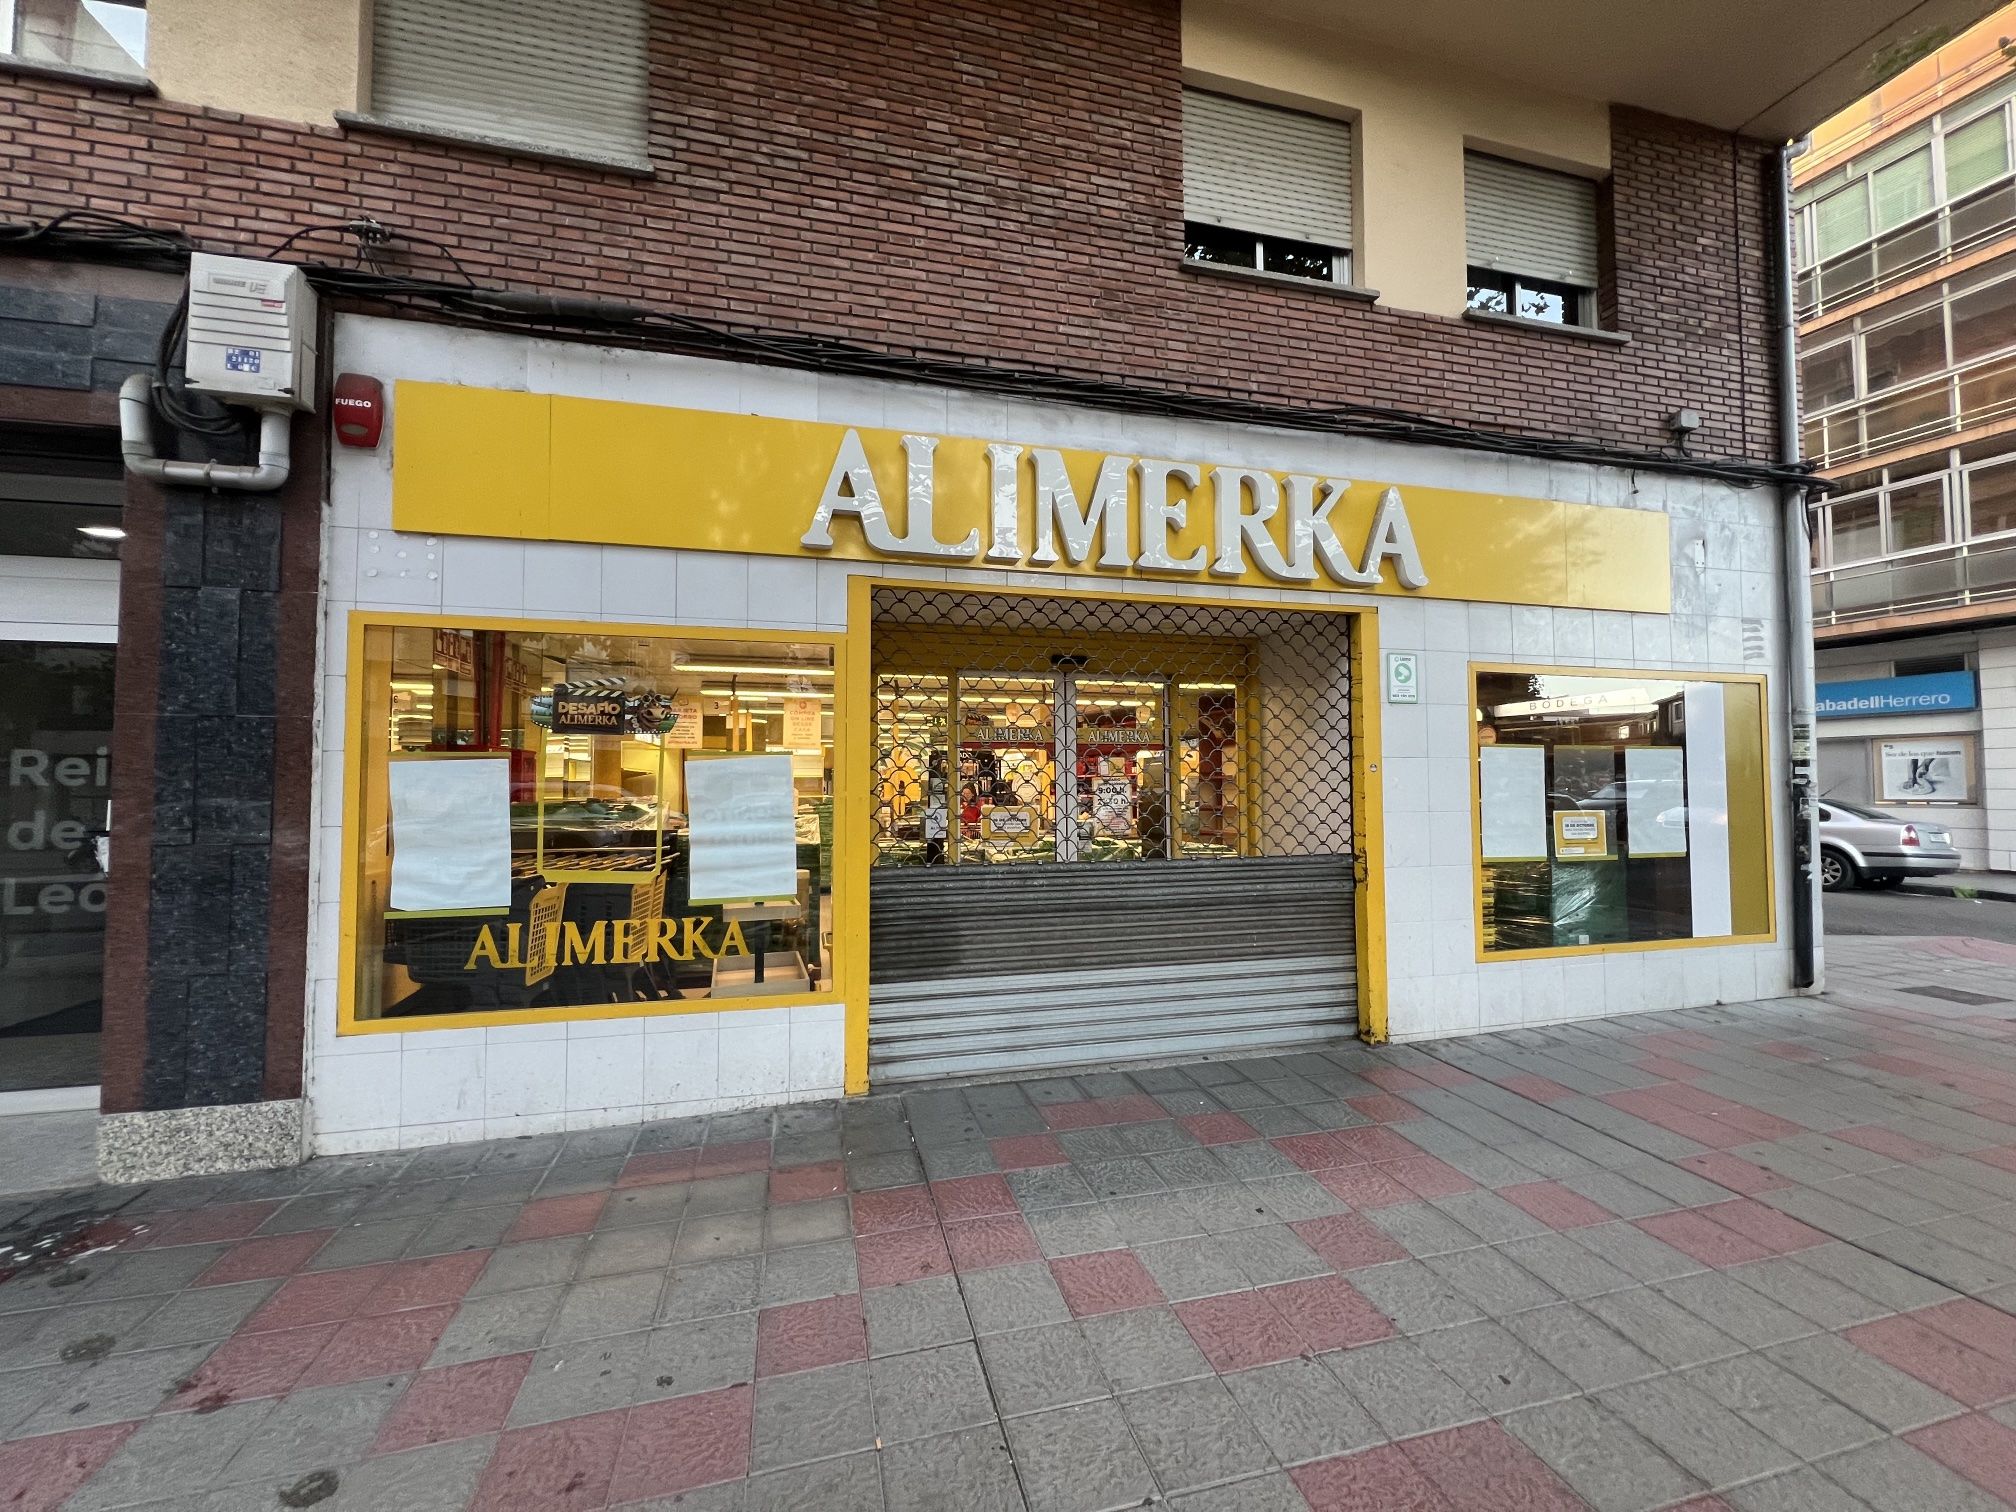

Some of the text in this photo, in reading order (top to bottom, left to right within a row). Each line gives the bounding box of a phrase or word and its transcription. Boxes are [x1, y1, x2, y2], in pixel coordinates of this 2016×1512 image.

[335, 398, 372, 408] FUEGO
[800, 428, 1430, 591] ALIMERKA
[714, 702, 719, 710] 3
[1529, 694, 1608, 711] BODEGA
[1815, 693, 1951, 712] abadellHerrero
[559, 714, 618, 726] ALIMERKA
[1098, 786, 1118, 794] 9:00
[7, 810, 85, 851] de
[464, 916, 751, 970] ALIMERKA
